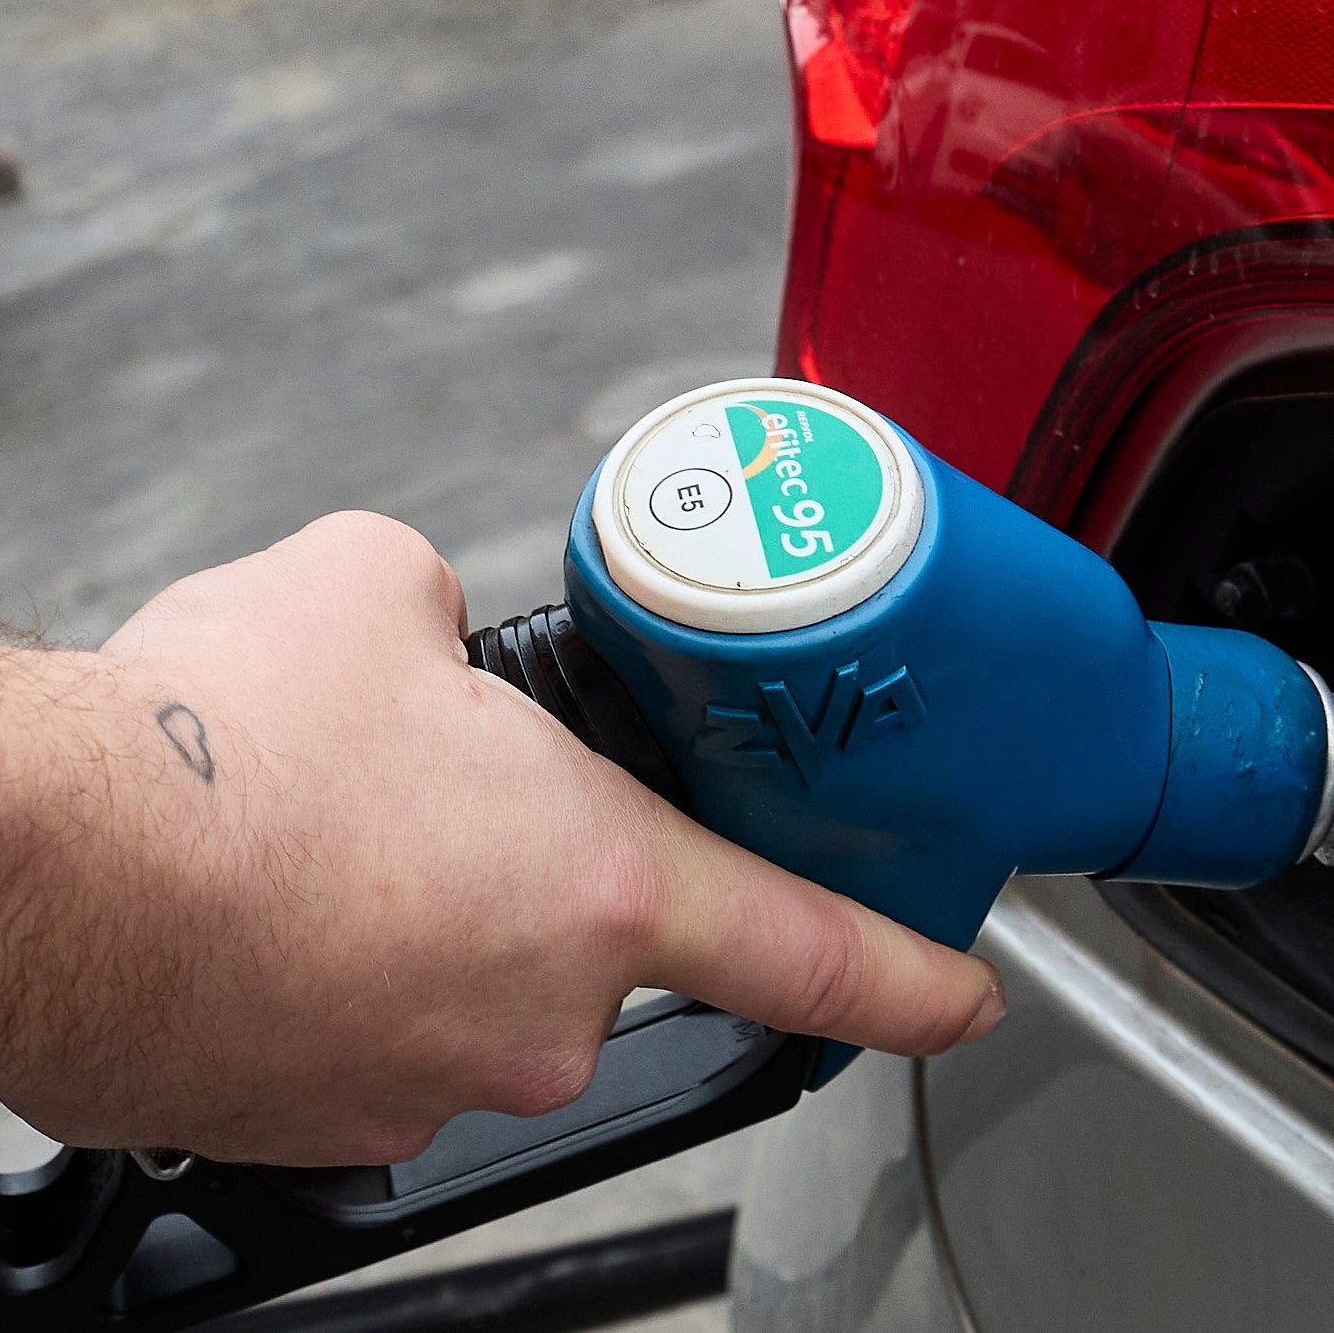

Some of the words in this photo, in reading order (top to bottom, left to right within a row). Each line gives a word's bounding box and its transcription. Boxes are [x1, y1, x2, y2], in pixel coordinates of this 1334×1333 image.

[761, 412, 808, 497] efitec
[676, 483, 705, 513] E5
[772, 499, 835, 558] 95
